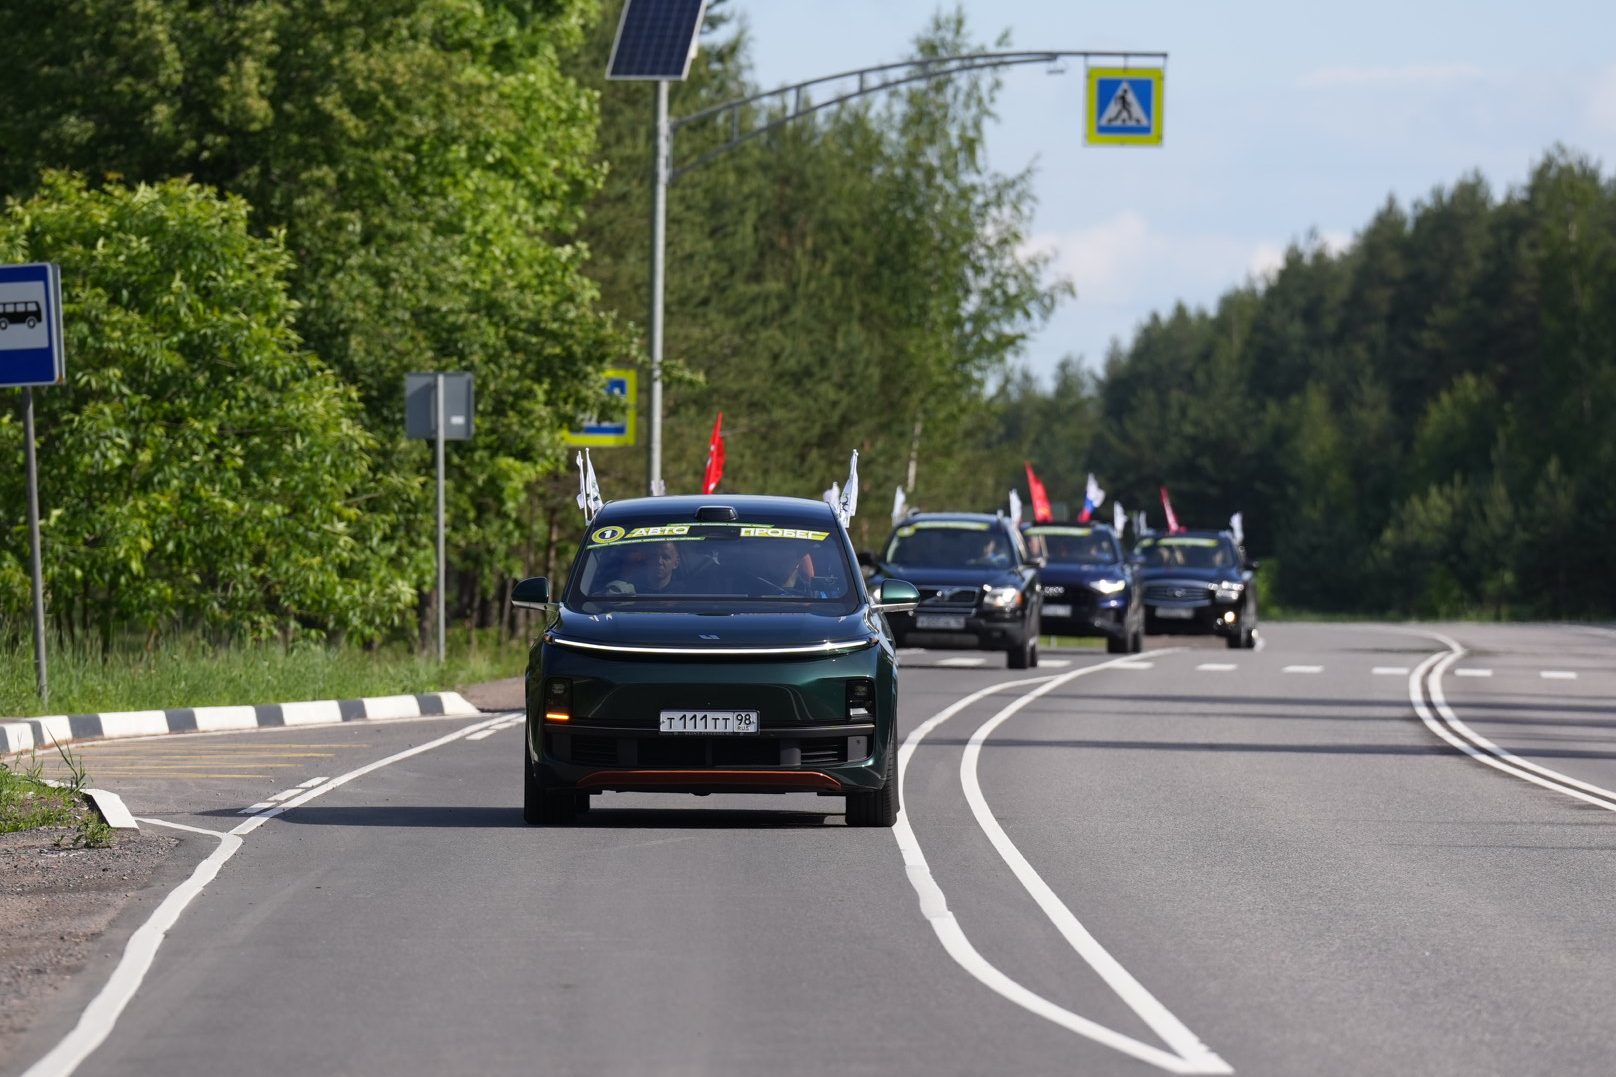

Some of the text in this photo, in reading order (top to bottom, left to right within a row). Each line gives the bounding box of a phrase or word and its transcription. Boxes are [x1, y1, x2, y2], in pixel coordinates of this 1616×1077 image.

[603, 530, 613, 539] 1
[631, 526, 825, 540] АВТО ПРОБЕГ
[736, 713, 752, 726] 98
